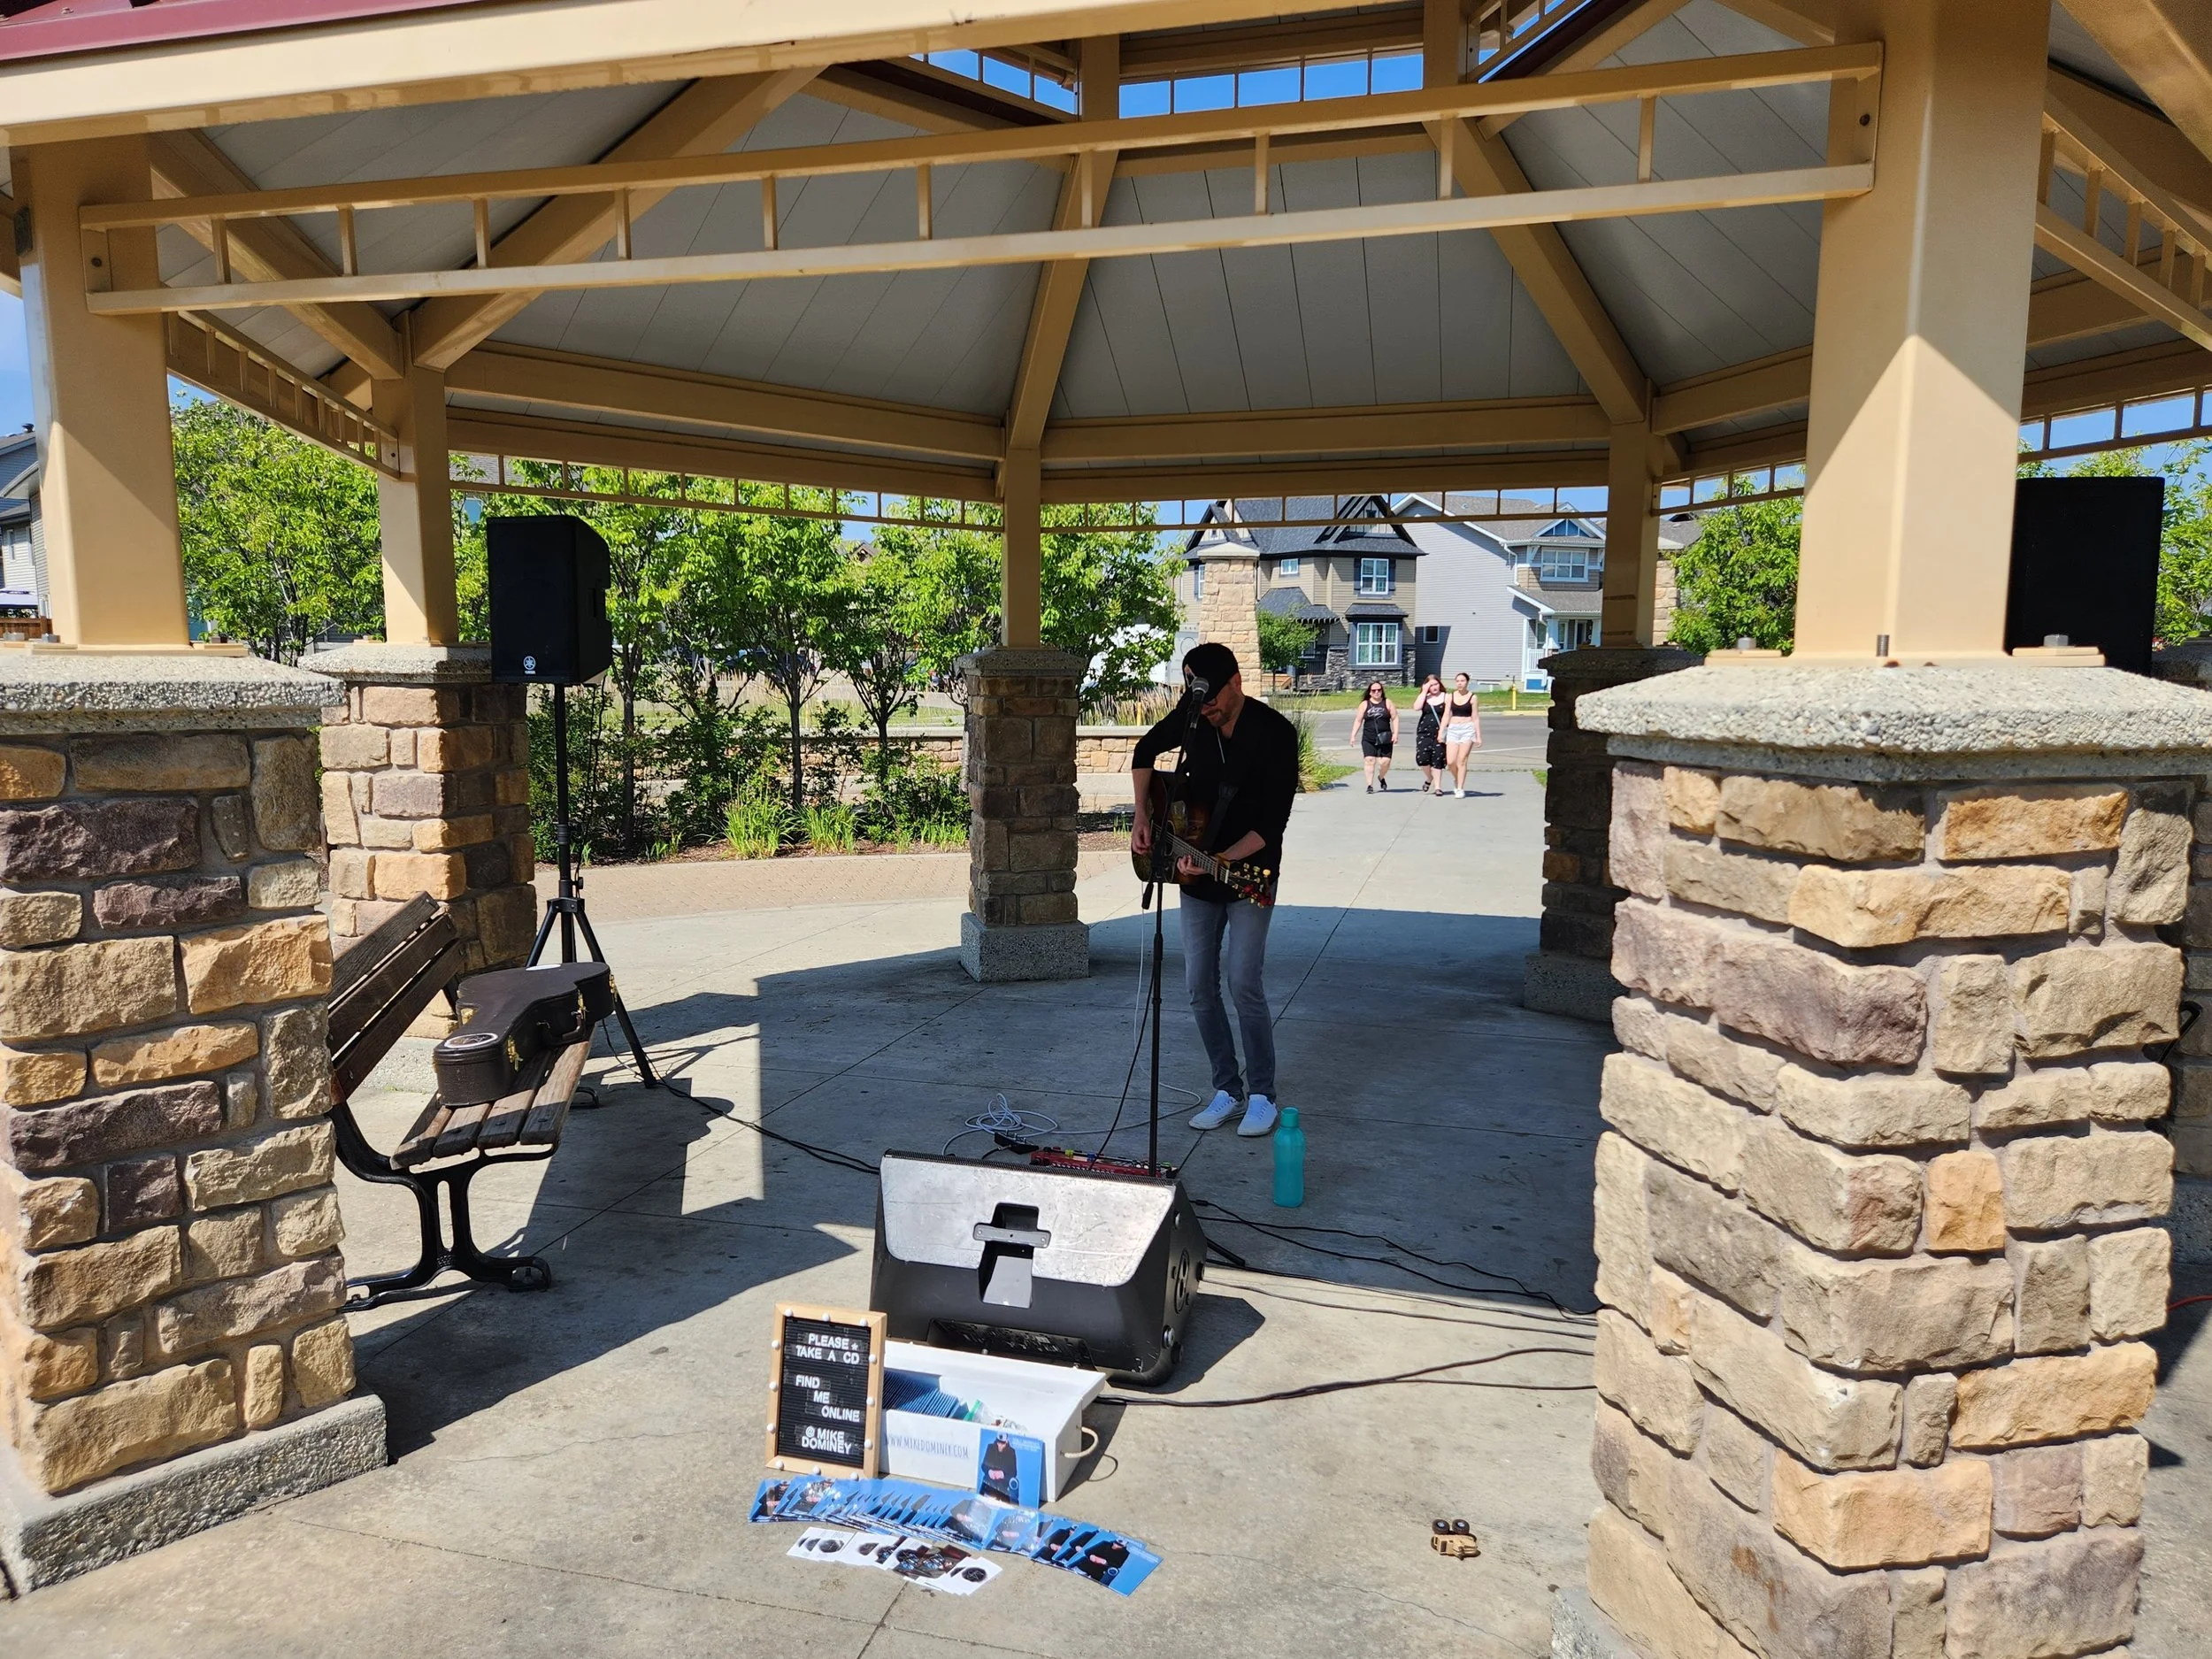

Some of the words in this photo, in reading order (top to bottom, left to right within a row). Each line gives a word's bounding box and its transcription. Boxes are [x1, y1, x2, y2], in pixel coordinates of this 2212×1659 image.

[808, 1333, 849, 1350] PLEASE
[795, 1345, 822, 1359] TAKE
[827, 1349, 836, 1363] A
[842, 1351, 860, 1364] CD
[795, 1374, 820, 1388] FIND
[813, 1390, 830, 1404] ME
[821, 1405, 860, 1423] ONLINE
[801, 1435, 852, 1455] DOMINEY
